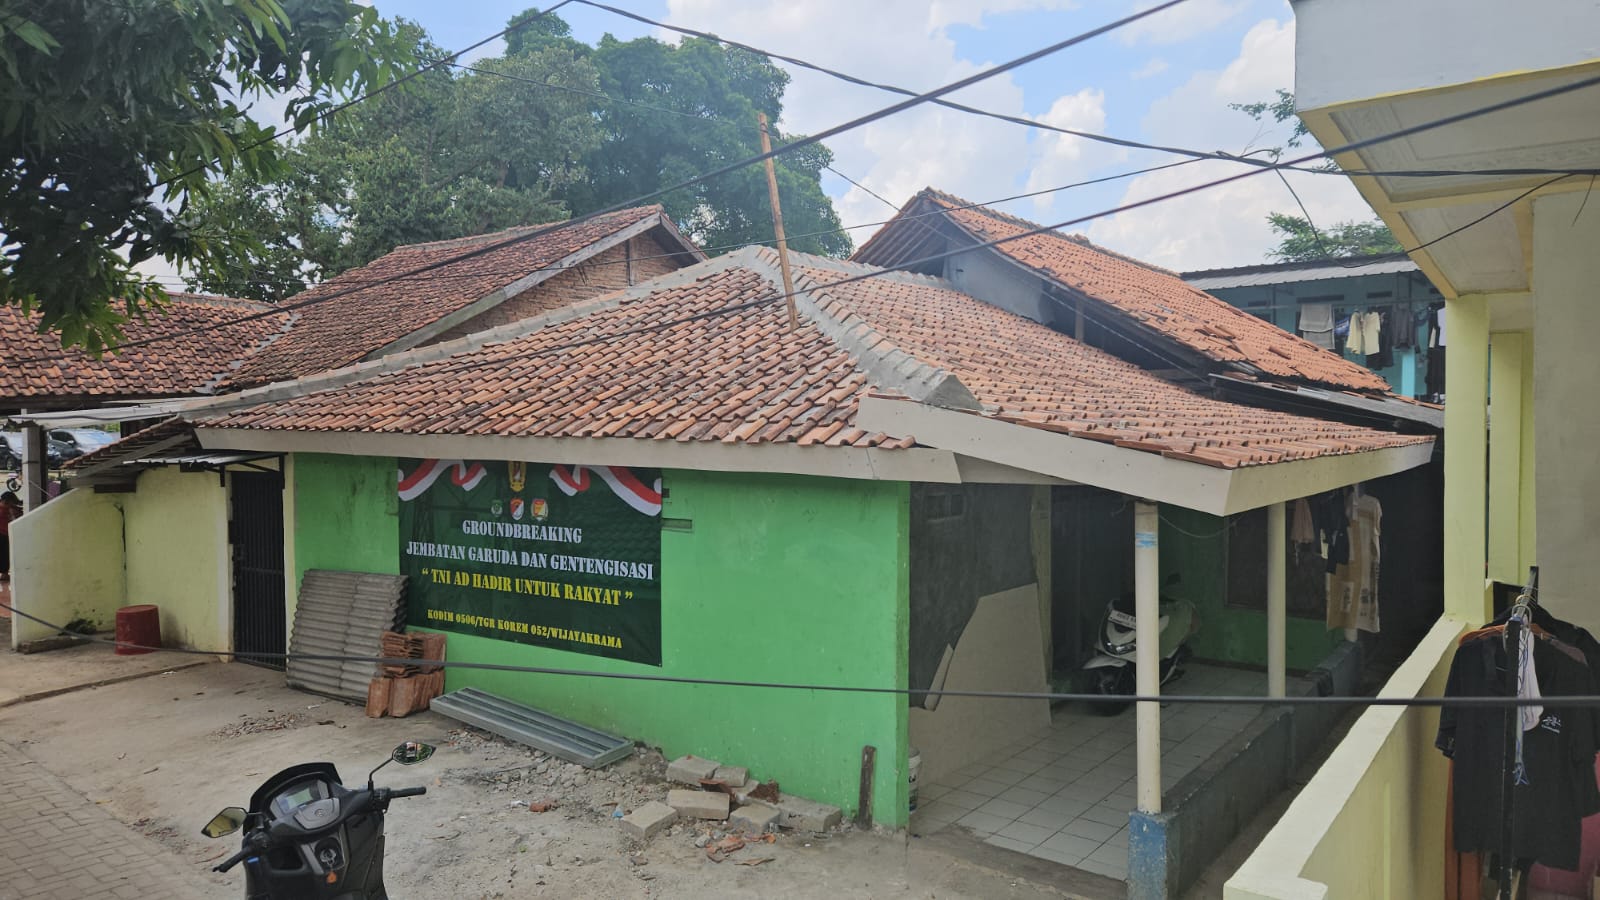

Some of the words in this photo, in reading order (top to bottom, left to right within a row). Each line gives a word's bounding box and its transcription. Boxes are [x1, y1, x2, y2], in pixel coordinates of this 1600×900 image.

[462, 520, 582, 543] GROUNDBREAKING
[406, 541, 466, 560] JEMBATAN
[468, 546, 518, 566] GARUDA
[521, 552, 547, 569] DAN
[550, 555, 653, 580] GENTENGISASI
[431, 569, 451, 585] TNI
[454, 571, 470, 586] AD
[472, 574, 512, 592] HADIR
[515, 578, 560, 598] UNTUK
[564, 584, 621, 605] RAKYAT
[427, 609, 454, 622] KODIM
[455, 614, 495, 628] 0506/TGR
[497, 620, 528, 634] KOREM
[530, 625, 622, 649] 052/WIJAYAKRAMA
